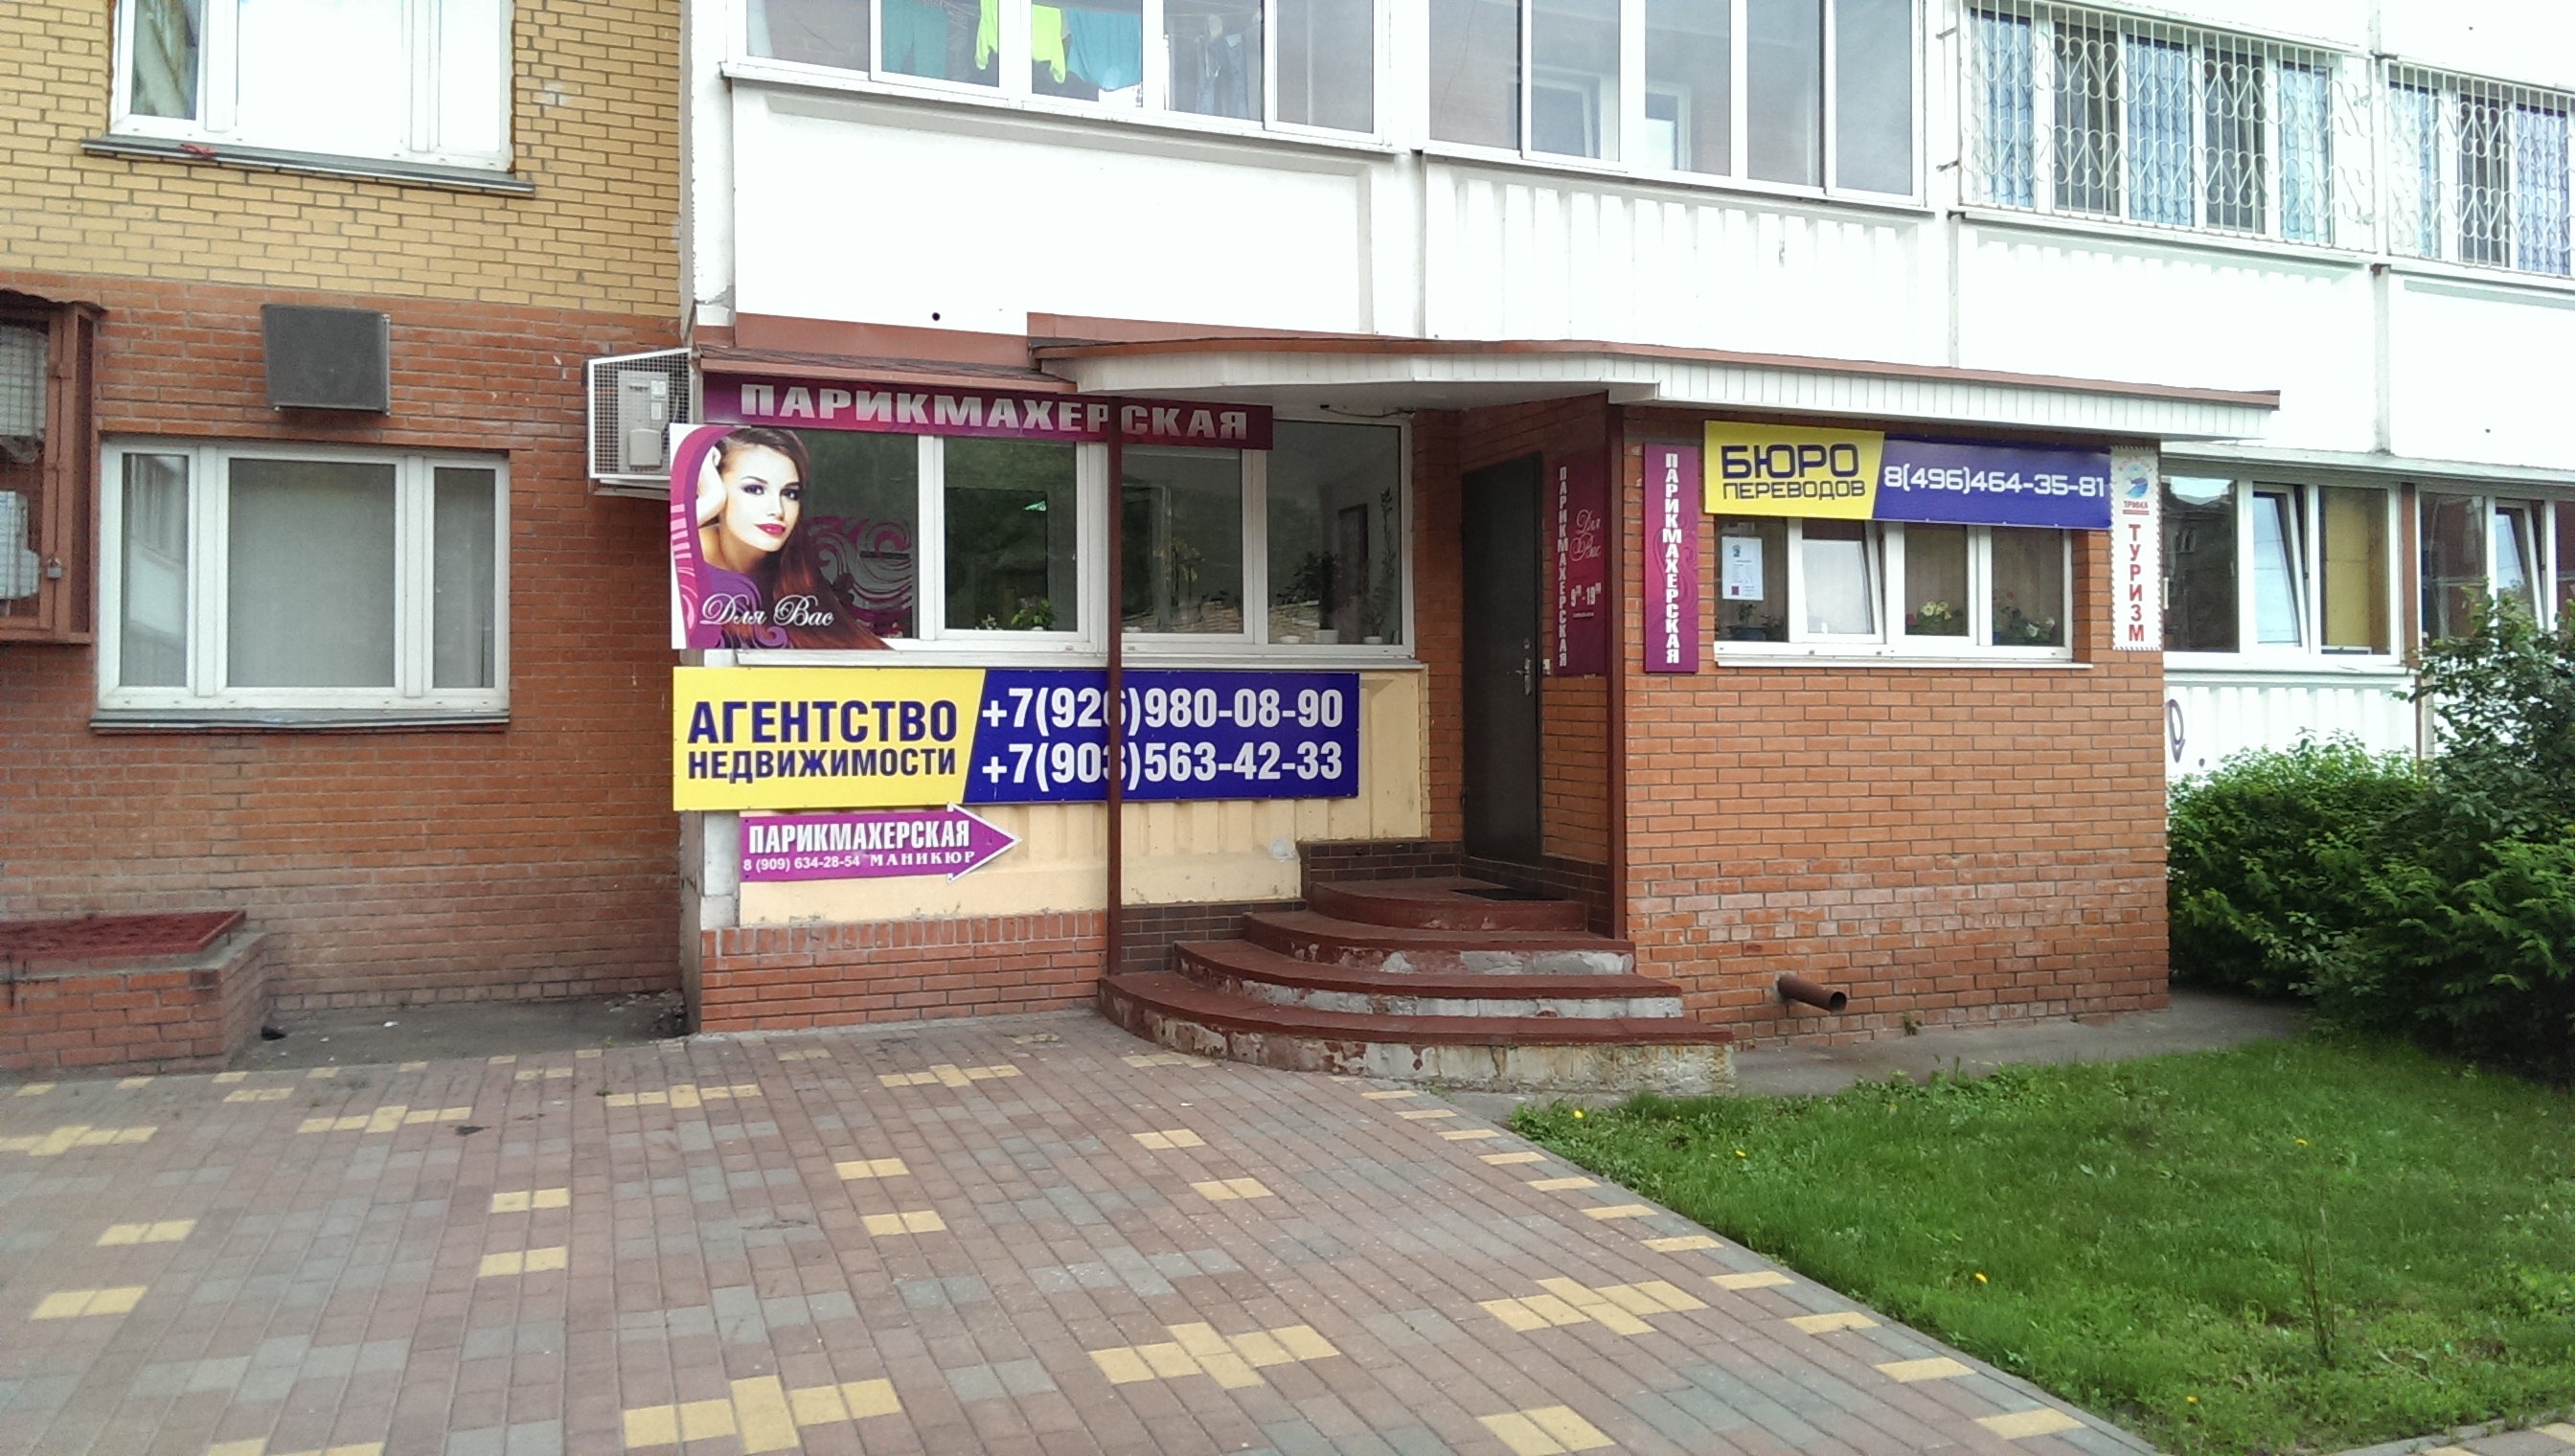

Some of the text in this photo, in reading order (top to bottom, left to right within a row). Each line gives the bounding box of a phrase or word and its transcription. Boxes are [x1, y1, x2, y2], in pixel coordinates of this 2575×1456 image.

[740, 384, 1247, 440] ПАРИКМАХЕРСКАЯ
[1720, 444, 1859, 480] БЮРО
[1883, 463, 2106, 498] 8(496)464-35-81
[1722, 480, 1866, 500] ПЕРЕВОДОВ
[1557, 466, 1569, 667] ПАРИКМАХЕРСКАЯ
[1662, 453, 1682, 663] ПАРИКМАХЕРСКАЯ
[2128, 523, 2145, 642] ТУРИЗМ
[699, 592, 835, 627] Для Вас
[687, 699, 957, 744] АГЕНТСТВО
[982, 687, 1343, 737] +7(926)980-08-90
[688, 747, 956, 785] НЕДВИЖИМОСТИ
[982, 740, 1343, 791] +7(903)563-42-33
[748, 820, 970, 854] ПАРИКМАХЕРСКАЯ
[742, 851, 975, 874] 8 (909) 634-28-54 МАНИКЮР
